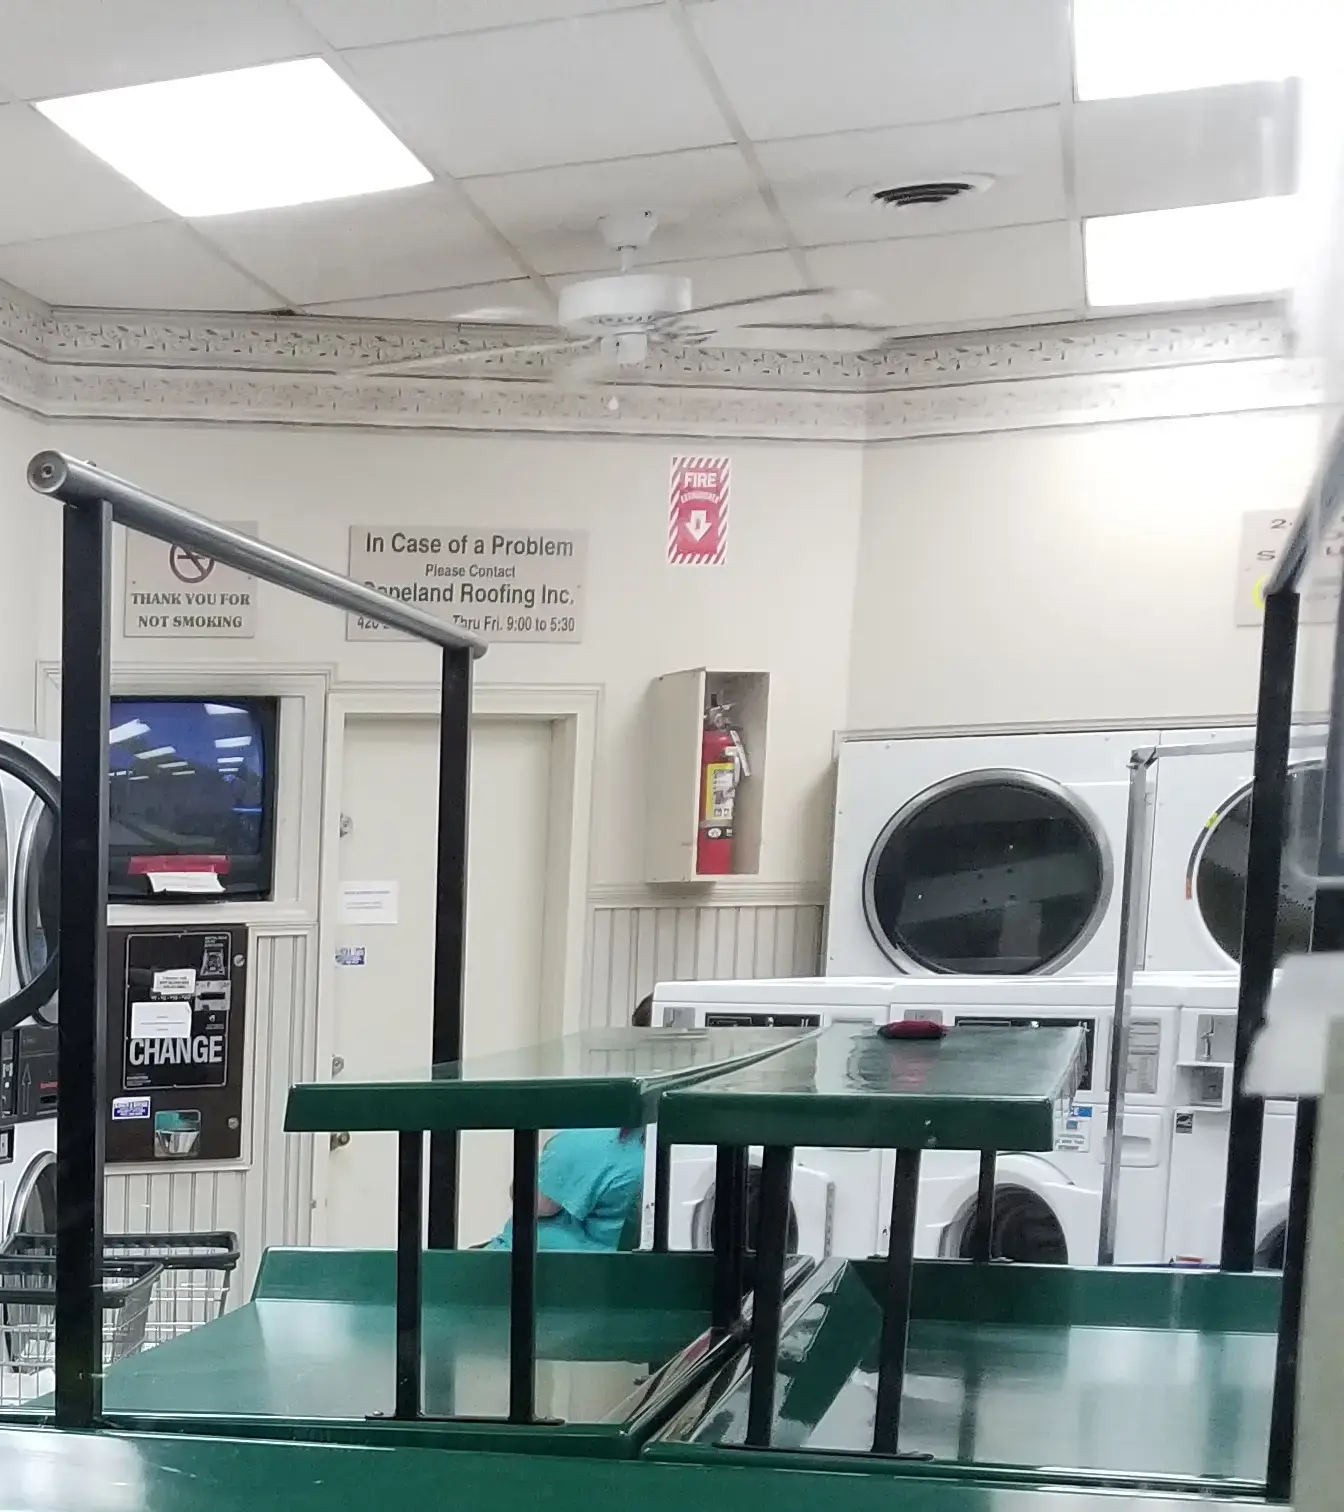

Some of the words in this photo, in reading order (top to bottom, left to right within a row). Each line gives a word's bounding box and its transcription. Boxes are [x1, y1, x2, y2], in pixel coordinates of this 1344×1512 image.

[684, 472, 717, 488] FIRE
[366, 532, 384, 552] In
[391, 532, 441, 553] Case
[448, 535, 467, 554] of
[473, 538, 484, 554] a
[492, 535, 574, 556] Problem
[425, 563, 465, 577] Please
[469, 564, 516, 578] Contact
[130, 593, 182, 605] THANK
[184, 593, 217, 605] YOU
[219, 593, 250, 605] FOR
[462, 583, 535, 608] Roofing
[138, 616, 169, 628] NOT
[172, 616, 243, 628] SMOKING
[484, 615, 503, 631] Fri.
[507, 616, 532, 631] 9:00
[535, 617, 547, 631] to
[550, 616, 575, 632] 5:30
[129, 1035, 223, 1066] CHANGE
